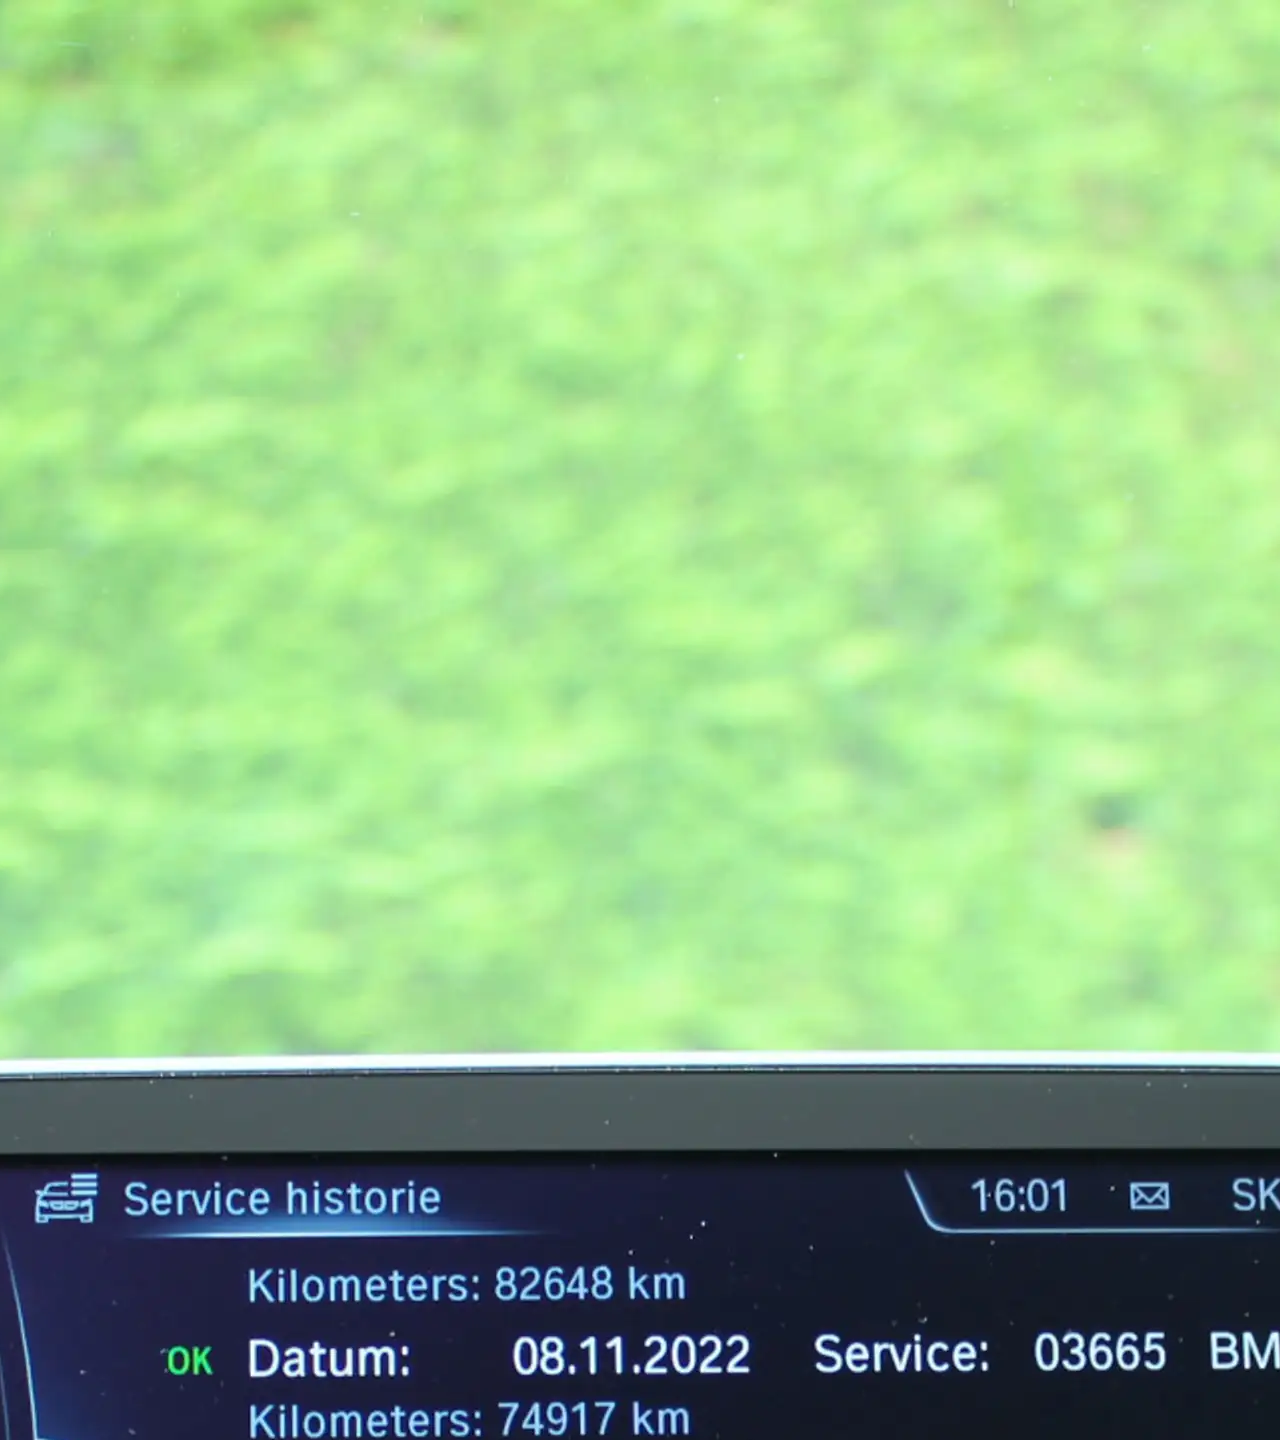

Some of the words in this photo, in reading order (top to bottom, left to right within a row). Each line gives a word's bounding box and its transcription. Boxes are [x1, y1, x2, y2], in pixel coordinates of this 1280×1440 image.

[124, 1181, 271, 1216] Service
[286, 1180, 442, 1215] historie
[971, 1178, 1066, 1212] 16:01
[249, 1268, 480, 1303] Kilometers:
[494, 1265, 614, 1301] 82648
[628, 1266, 685, 1300] km
[167, 1345, 213, 1376] OK
[249, 1338, 409, 1378] Datum:
[513, 1334, 750, 1376] 08.11.2022
[814, 1333, 989, 1373] Service:
[1034, 1331, 1166, 1372] 03665
[249, 1404, 482, 1439] Kilometers:
[497, 1401, 616, 1437] 74917
[632, 1401, 690, 1436] km
